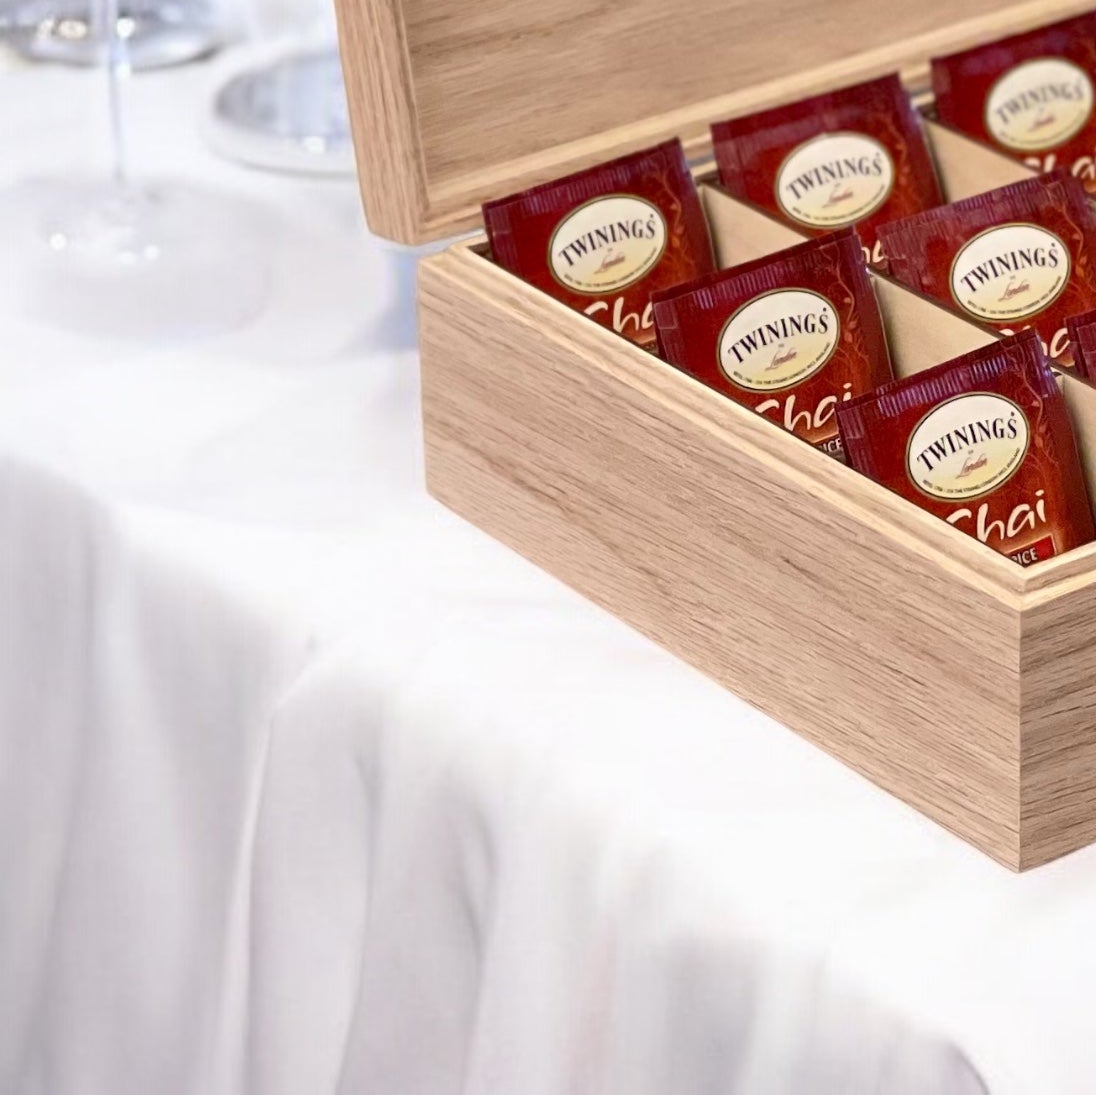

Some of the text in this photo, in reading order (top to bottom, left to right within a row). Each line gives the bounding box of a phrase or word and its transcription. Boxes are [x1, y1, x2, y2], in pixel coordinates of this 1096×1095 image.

[786, 156, 883, 201] TWININGS
[559, 218, 657, 267] TWININGS
[961, 247, 1059, 292] TWININGS
[728, 313, 829, 363] TWININGS
[916, 417, 1018, 472] TWININGS
